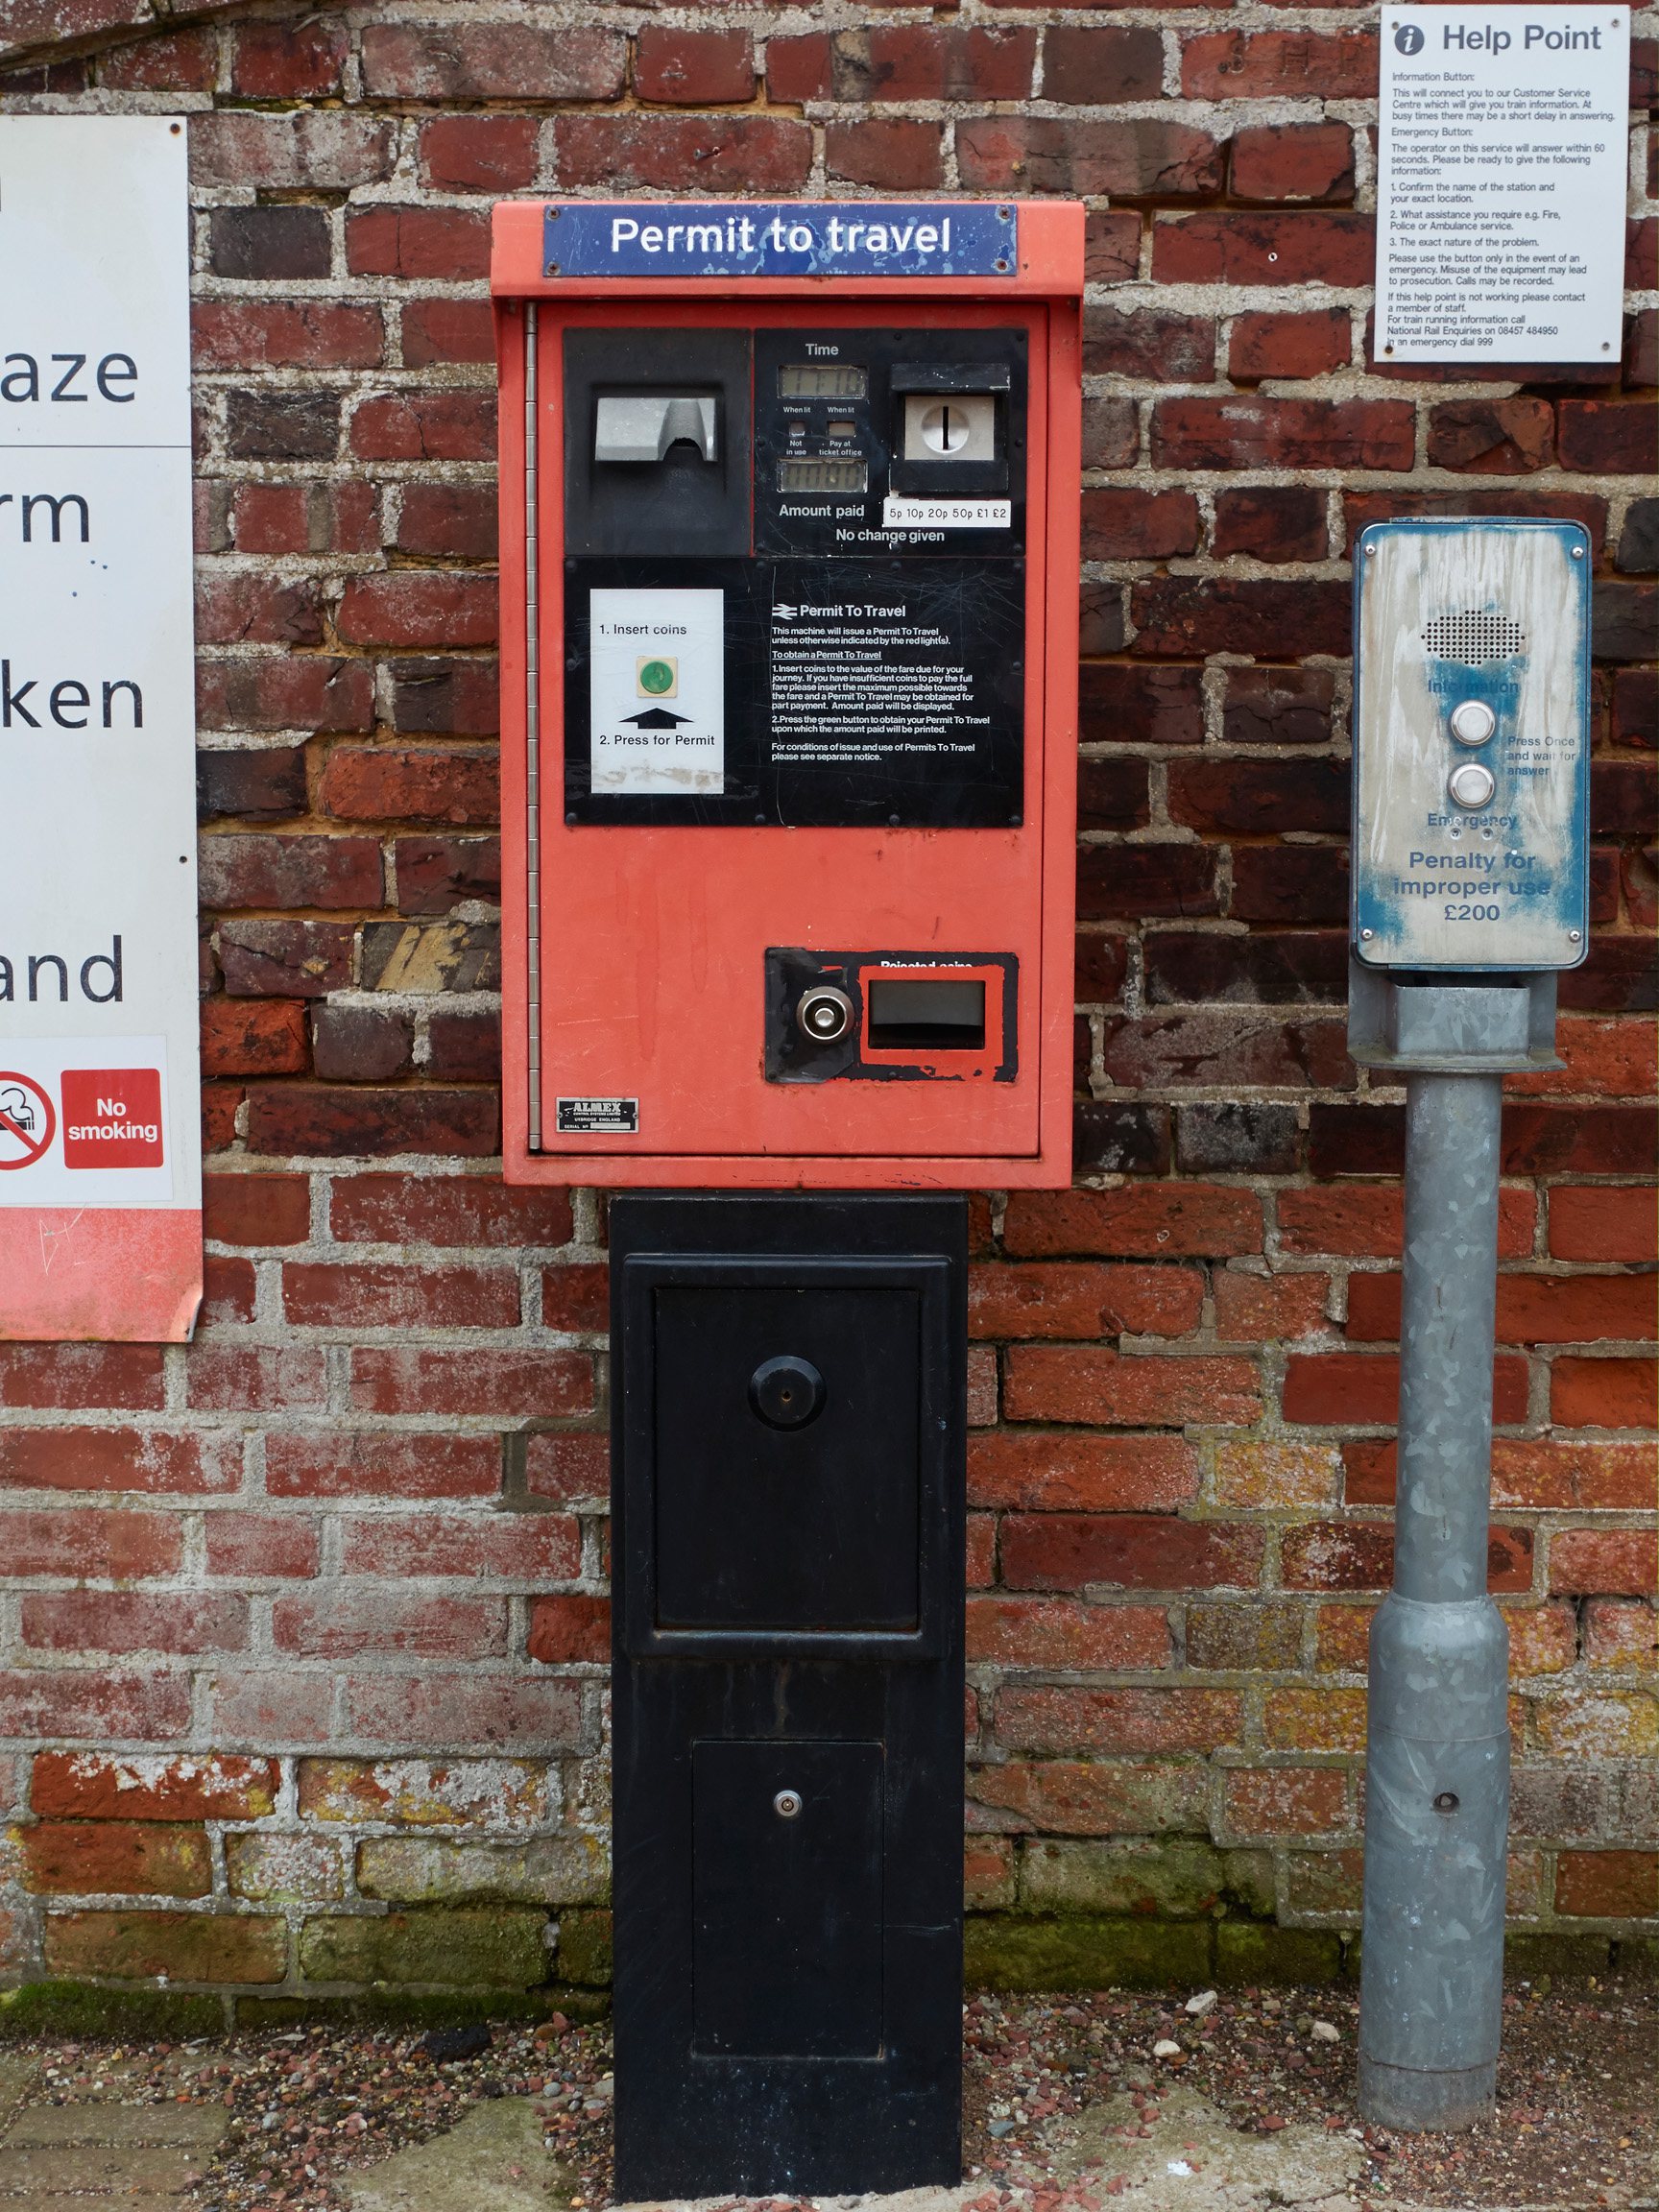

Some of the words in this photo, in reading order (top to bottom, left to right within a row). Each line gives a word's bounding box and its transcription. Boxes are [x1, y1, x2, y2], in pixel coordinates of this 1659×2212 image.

[1444, 25, 1510, 56] Help
[1525, 24, 1601, 50] Point
[1392, 72, 1441, 81] Information
[1443, 72, 1475, 81] Button:
[1393, 88, 1410, 98] This
[1412, 88, 1428, 98] will
[1430, 89, 1465, 98] connect
[1467, 90, 1482, 100] you
[1484, 89, 1494, 98] to
[1513, 88, 1555, 98] Customer
[1557, 88, 1591, 98] Service
[1392, 100, 1422, 108] Centre
[1424, 100, 1450, 108] which
[1452, 100, 1466, 108] will
[1468, 100, 1486, 110] give
[1488, 102, 1504, 110] you
[1506, 100, 1527, 108] train
[1528, 100, 1579, 108] information.
[1582, 100, 1592, 108] At
[1392, 110, 1413, 122] busy
[1415, 110, 1439, 120] times
[1441, 110, 1464, 120] there
[1466, 113, 1484, 122] may
[1486, 110, 1498, 120] be
[1508, 110, 1531, 120] short
[1533, 110, 1557, 122] delay
[1559, 110, 1567, 120] in
[1569, 110, 1615, 122] answering.
[1391, 128, 1439, 138] Emergency
[1441, 128, 1474, 136] Button:
[1392, 143, 1407, 153] The
[1409, 144, 1447, 155] operator
[1462, 143, 1479, 153] this
[1481, 143, 1513, 153] service
[1515, 143, 1529, 153] will
[1565, 143, 1592, 153] within
[1594, 143, 1605, 153] 60
[1391, 155, 1430, 164] seconds.
[1432, 155, 1461, 164] Please
[1463, 155, 1475, 164] be
[1478, 155, 1503, 166] ready
[1504, 156, 1514, 164] to
[1516, 155, 1534, 166] give
[1536, 155, 1551, 164] the
[1552, 155, 1591, 166] following
[1391, 166, 1442, 175] information:
[612, 218, 754, 253] Permit
[771, 221, 812, 253] to
[829, 218, 950, 253] travel
[1387, 325, 1422, 335] National
[1424, 325, 1440, 335] Rail
[1442, 325, 1482, 337] Enquiries
[1498, 326, 1524, 335] 08457
[1526, 326, 1558, 335] 484950
[805, 344, 839, 355] Time
[0, 352, 138, 402] aze
[779, 505, 831, 517] Amount
[836, 505, 864, 518] paid
[890, 509, 902, 520] 5p
[907, 509, 924, 520] 10p
[928, 509, 949, 520] 20p
[952, 509, 973, 520] 50p
[977, 508, 989, 518] £1
[993, 508, 1006, 518] £2
[836, 529, 855, 541] No
[857, 529, 907, 543] change
[909, 529, 945, 543] given
[800, 604, 844, 617] Permit
[845, 605, 862, 617] To
[863, 604, 906, 617] Travel
[599, 624, 609, 635] 1.
[613, 624, 648, 635] Insert
[653, 624, 686, 635] coins
[772, 627, 790, 636] This
[790, 627, 826, 636] machine
[827, 627, 841, 636] will
[843, 627, 865, 636] issue
[873, 627, 901, 636] Permit
[901, 627, 912, 636] To
[912, 627, 939, 636] Travel
[771, 636, 799, 644] unless
[799, 636, 840, 644] otherwise
[840, 636, 879, 644] indicated
[879, 636, 890, 646] by
[890, 636, 904, 644] the
[905, 636, 920, 644] red
[920, 636, 950, 646] light(s).
[1, 660, 144, 729] ken
[599, 735, 611, 746] 2.
[613, 734, 648, 746] Press
[652, 734, 671, 746] for
[675, 734, 714, 746] Permit
[1508, 735, 1541, 747] Press
[1545, 735, 1575, 747] Once
[786, 742, 829, 751] conditions
[830, 742, 839, 751] of
[839, 742, 861, 751] issue
[861, 742, 878, 751] and
[894, 742, 903, 751] of
[904, 742, 937, 751] Permits
[950, 742, 975, 751] Travel
[771, 752, 799, 762] please
[816, 753, 854, 762] separate
[854, 752, 882, 760] notice.
[1508, 750, 1530, 760] and
[1533, 750, 1556, 760] wait
[1559, 750, 1575, 760] for
[1508, 766, 1549, 776] answer
[1428, 813, 1517, 830] Emergency
[1409, 852, 1494, 872] Penalty
[1503, 852, 1535, 869] for
[1394, 879, 1502, 899] improper
[1509, 881, 1551, 895] use
[1444, 904, 1500, 921] £200
[97, 1098, 127, 1117] No
[573, 1102, 621, 1112] ALMEX
[68, 1121, 157, 1142] smoking
